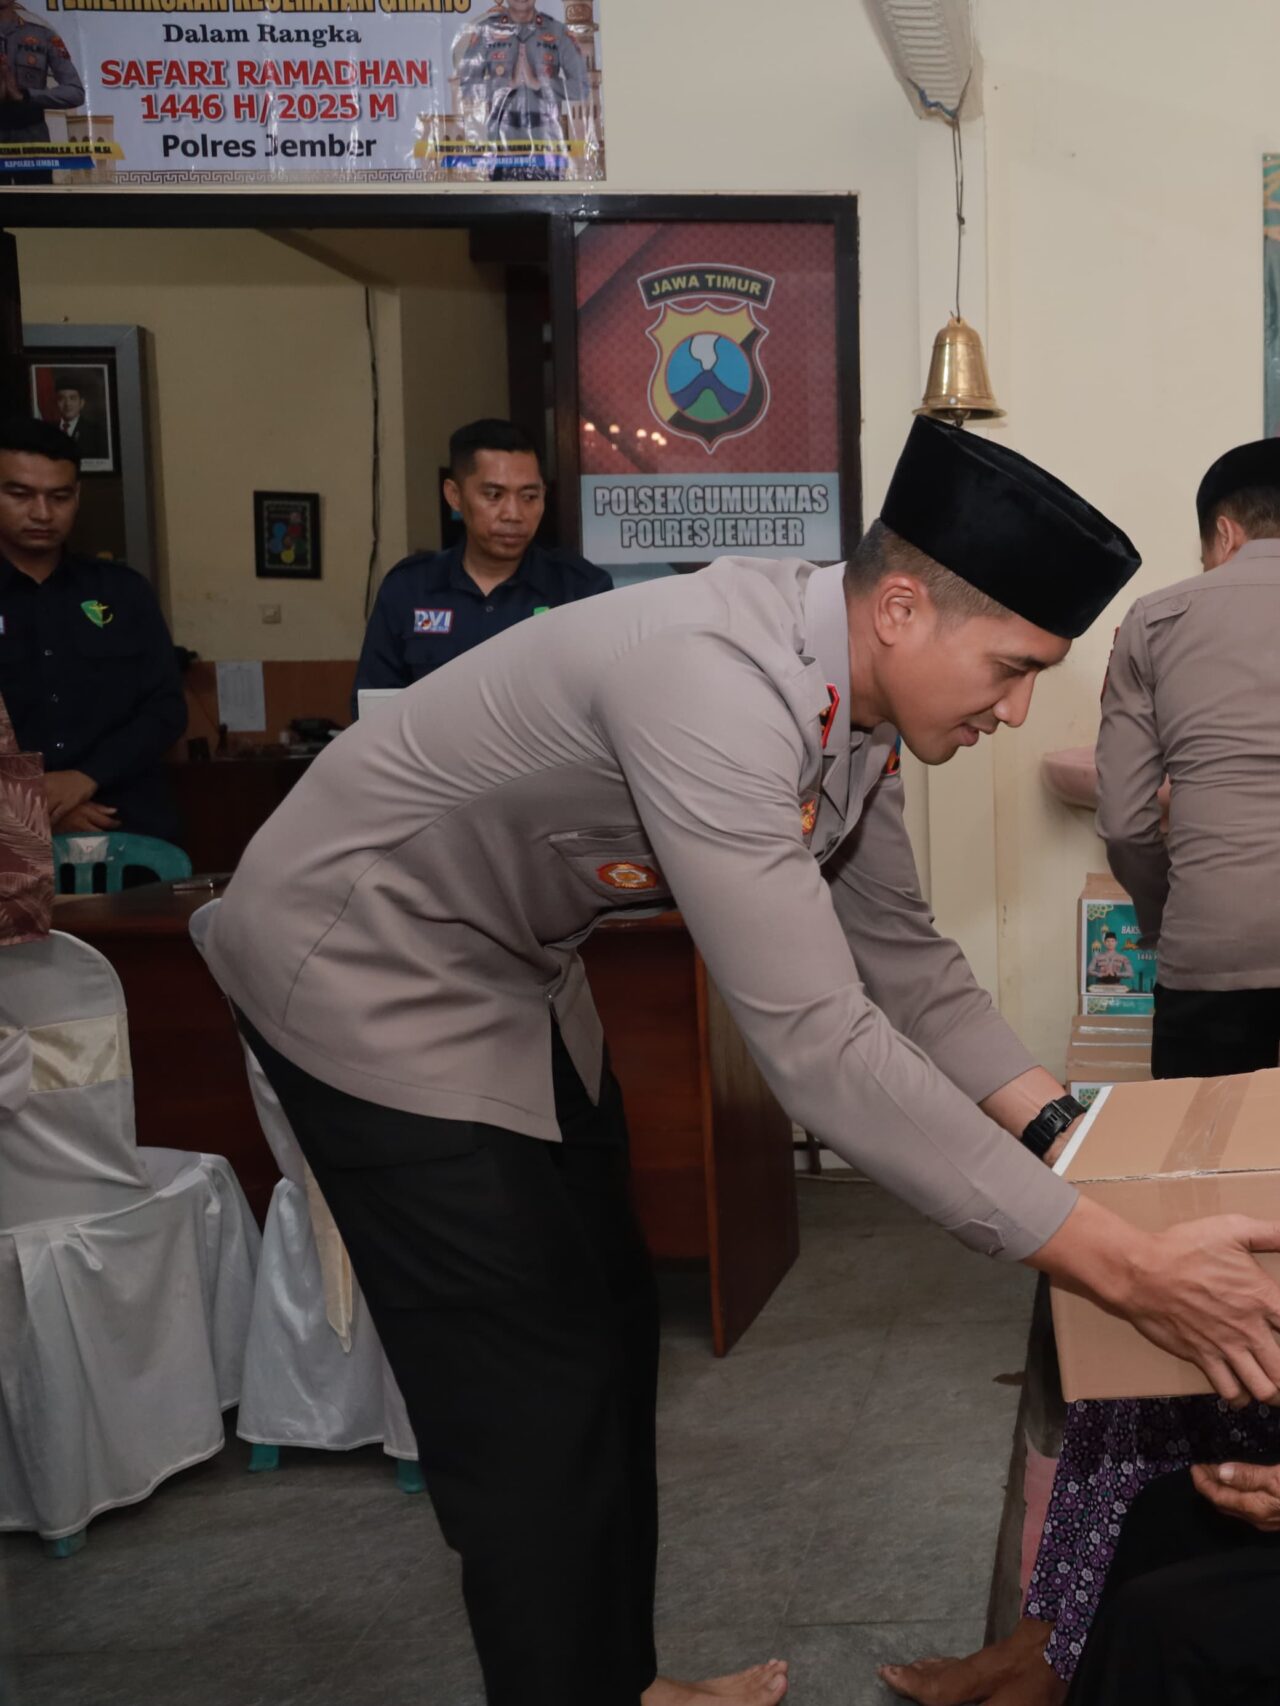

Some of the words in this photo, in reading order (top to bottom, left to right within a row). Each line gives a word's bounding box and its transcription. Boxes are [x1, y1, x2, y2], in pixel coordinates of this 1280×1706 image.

[163, 24, 249, 43] Dalam
[257, 24, 361, 47] Rangka
[101, 60, 227, 86] SAFARI
[236, 60, 429, 86] RAMADHAN
[141, 94, 222, 120] 1446
[370, 94, 397, 120] M
[162, 134, 256, 157] Polres
[265, 134, 376, 157] Jember
[651, 275, 700, 296] JAWA
[705, 274, 762, 296] TIMUR
[594, 485, 684, 515] POLSEK
[687, 485, 828, 514] GUMUKMAS
[621, 519, 709, 548] POLRES
[714, 518, 804, 546] JEMBER
